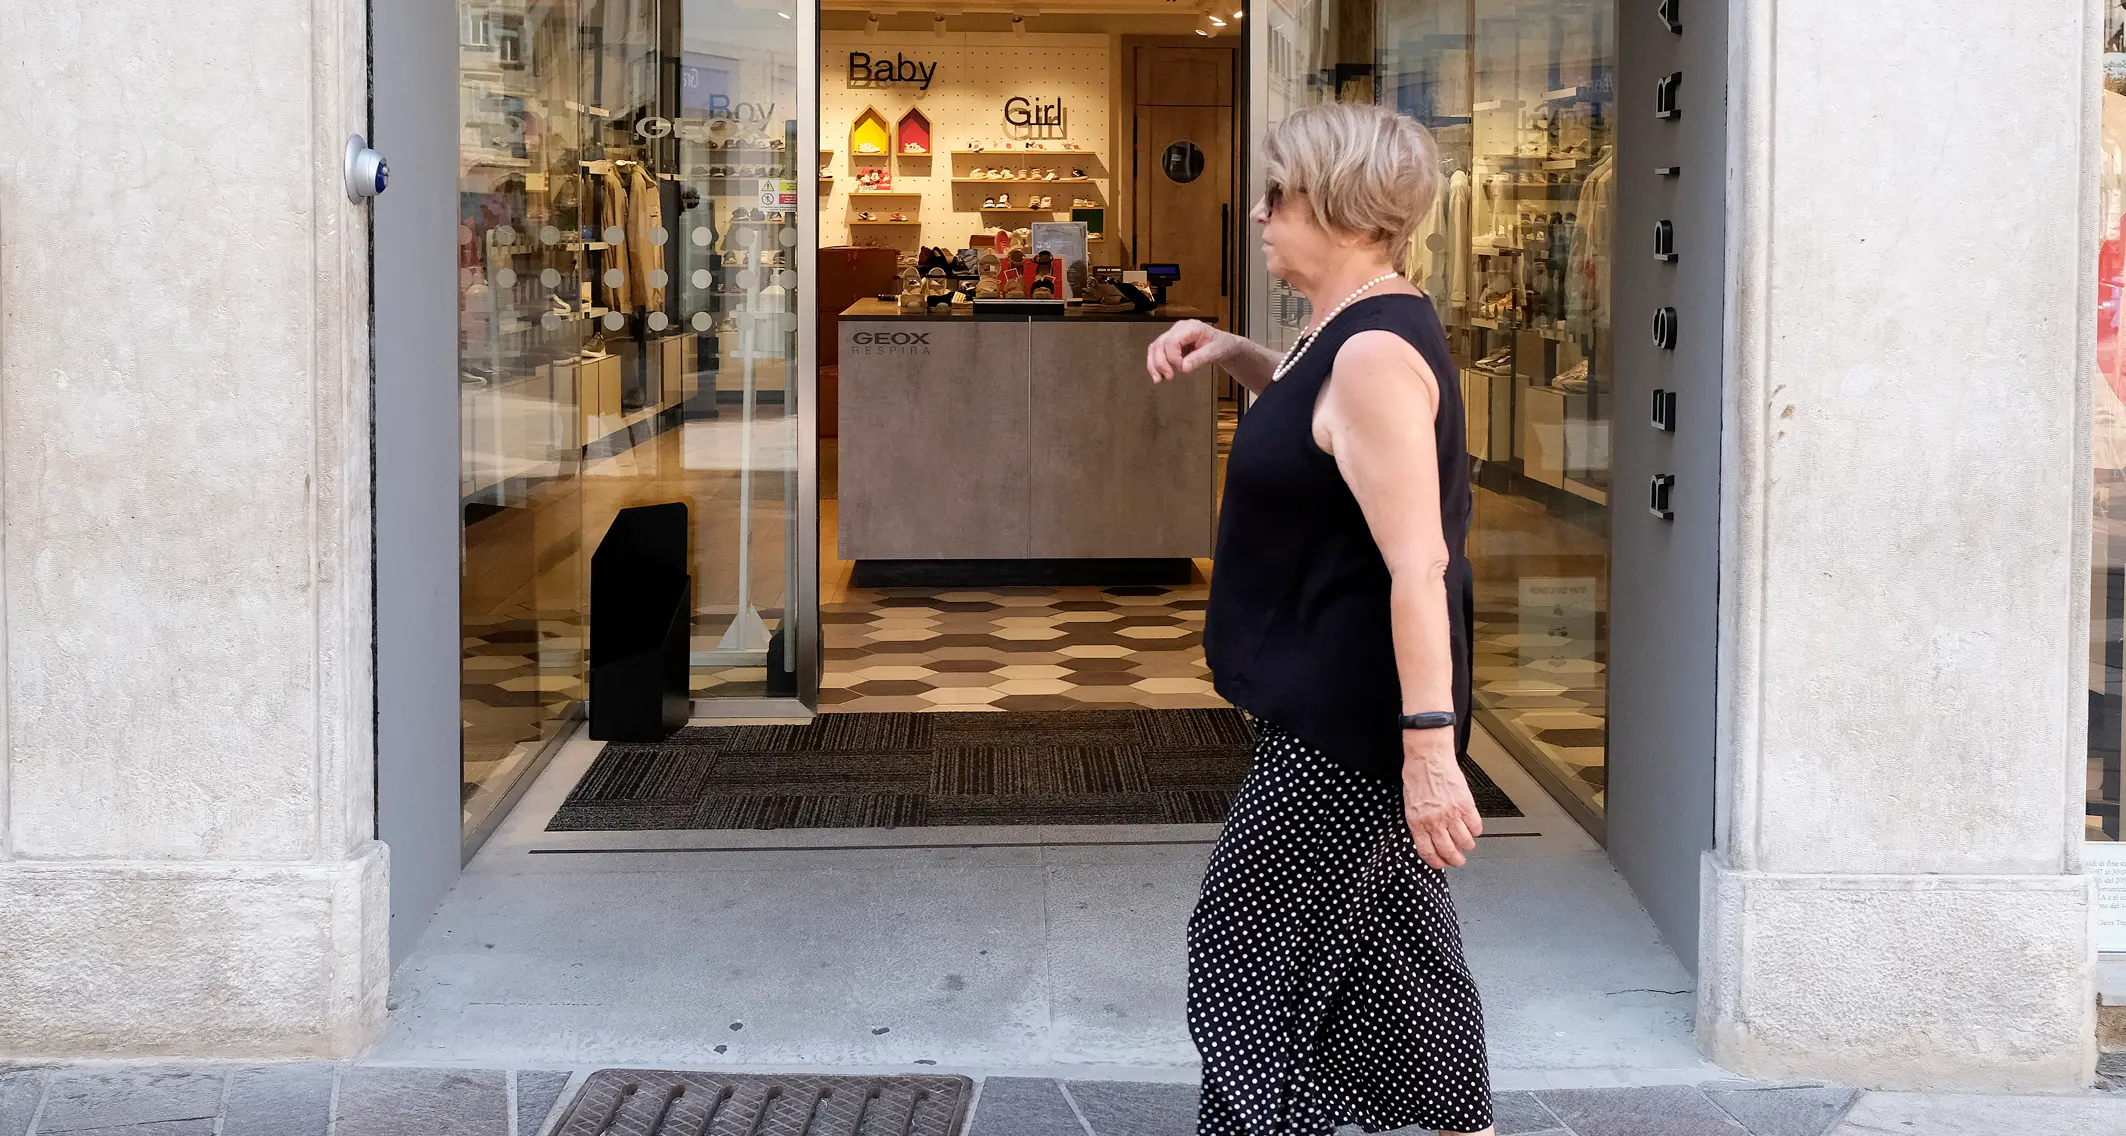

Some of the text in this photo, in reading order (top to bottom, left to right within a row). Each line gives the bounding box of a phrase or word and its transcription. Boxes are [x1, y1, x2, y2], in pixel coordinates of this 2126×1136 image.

[849, 51, 937, 91] Baby
[1004, 96, 1062, 126] Girl
[1649, 0, 1682, 519] RESPIRA
[852, 332, 930, 345] GEOX
[852, 346, 931, 355] RESPIRA
